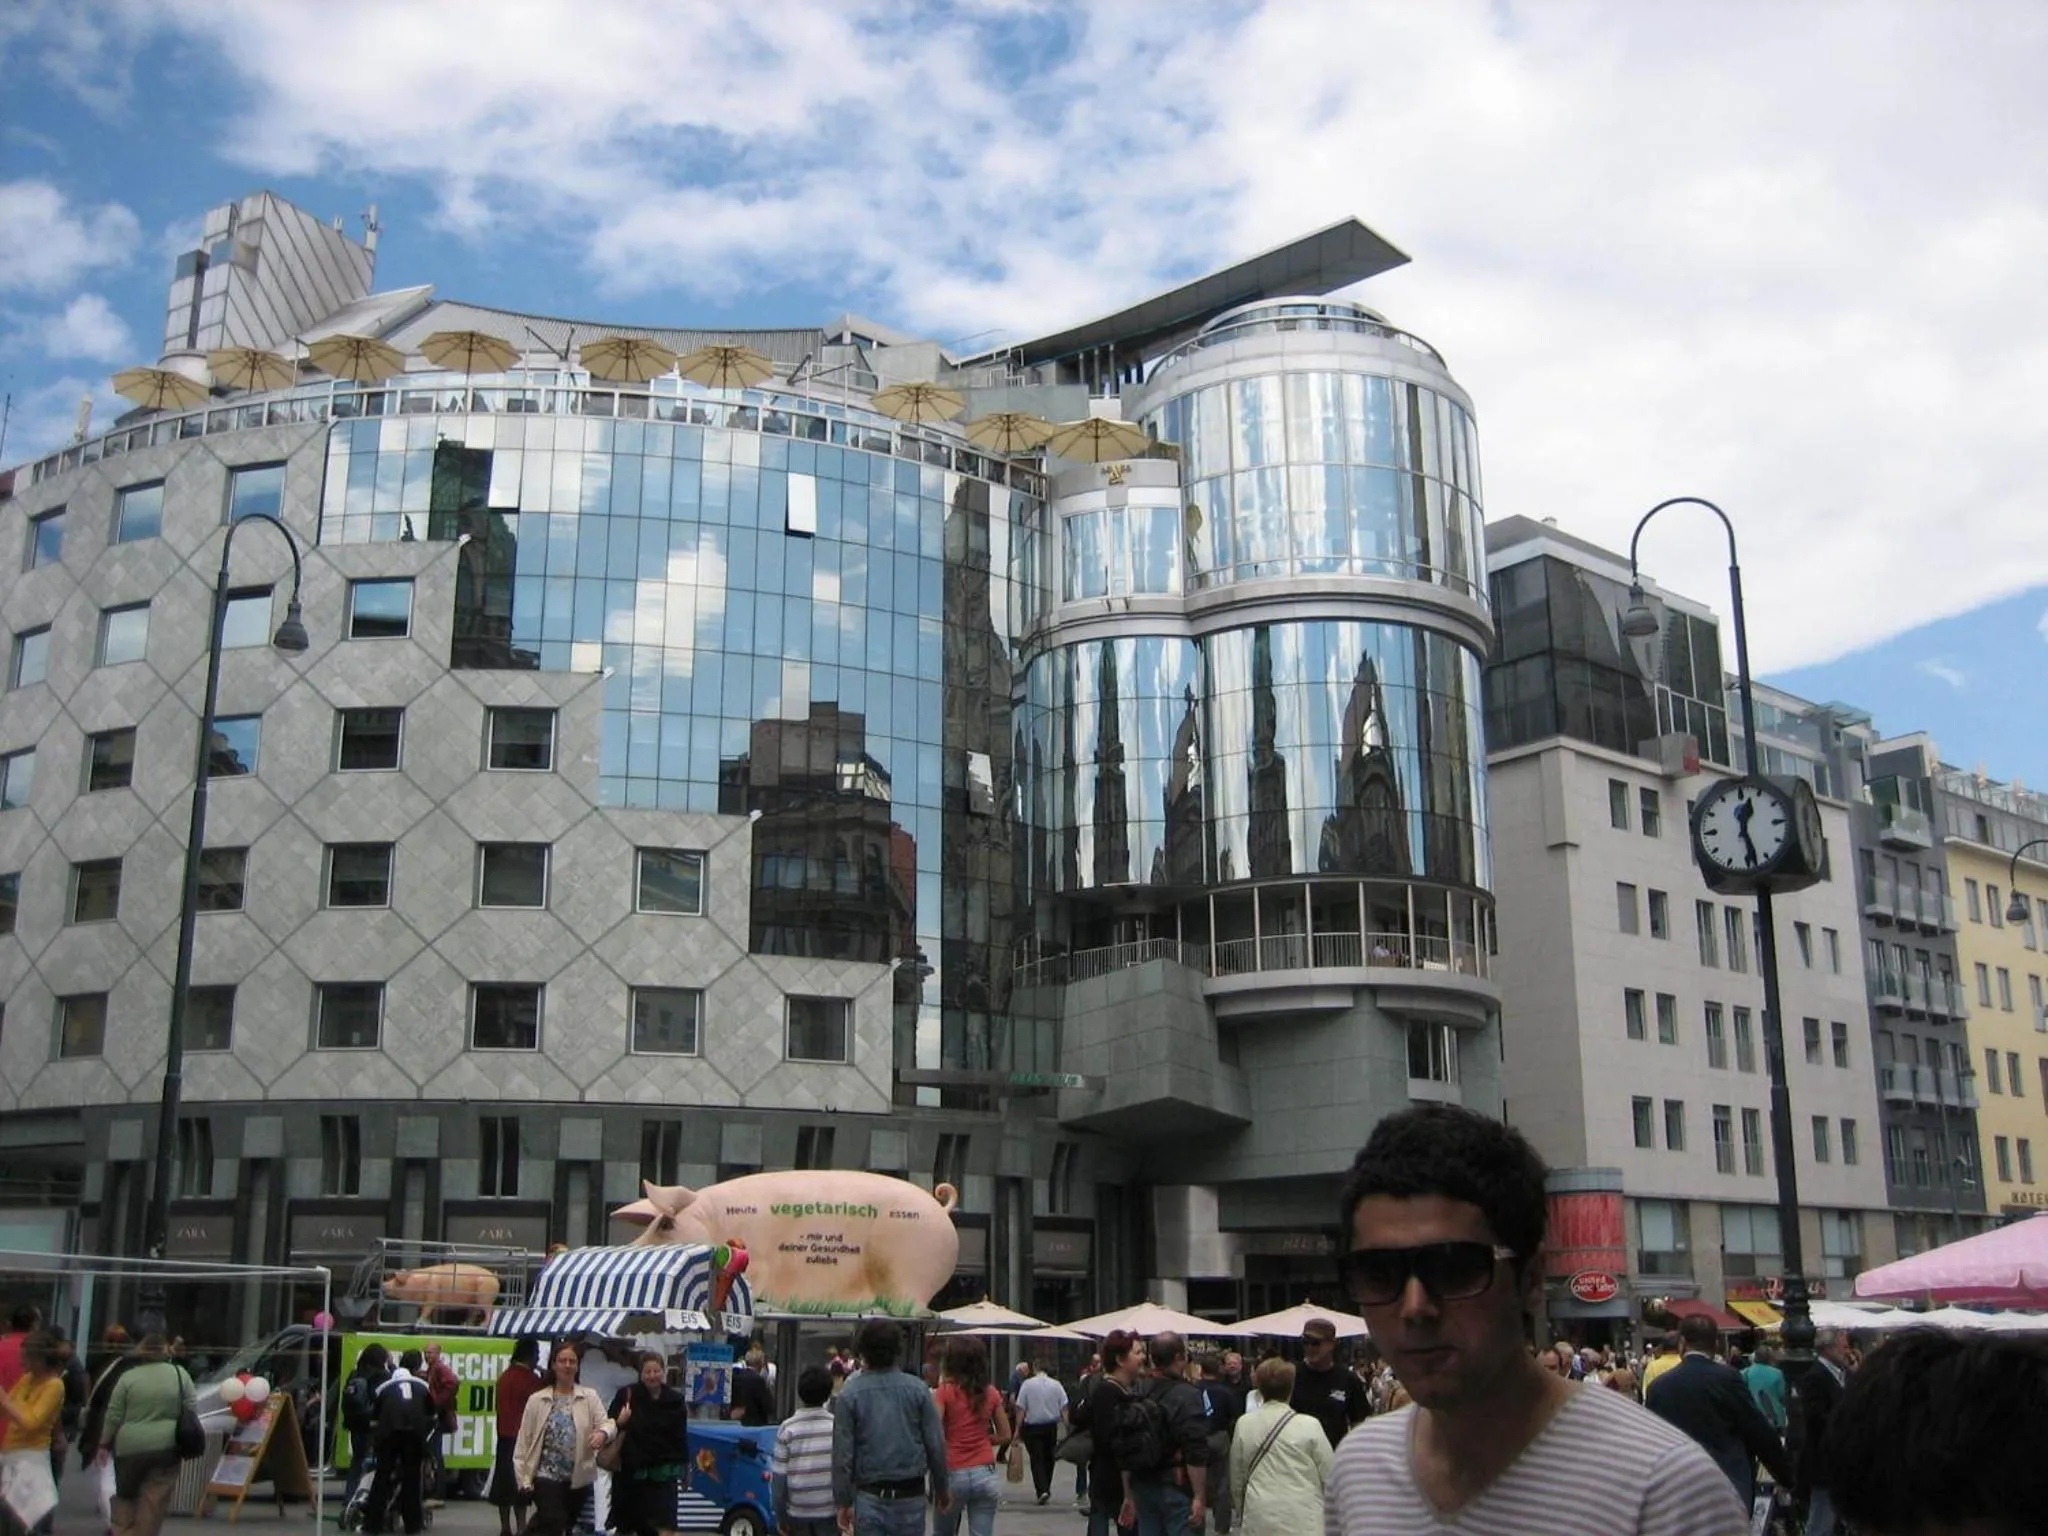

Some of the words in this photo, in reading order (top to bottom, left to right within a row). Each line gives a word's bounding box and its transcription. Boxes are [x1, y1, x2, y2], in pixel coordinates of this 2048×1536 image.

[726, 1205, 758, 1216] Heute
[770, 1201, 878, 1219] vegetarisch
[889, 1210, 919, 1220] essen
[806, 1233, 822, 1242] mir
[825, 1233, 843, 1243] und
[778, 1243, 808, 1253] deiner
[810, 1243, 860, 1255] Gesundheit
[806, 1255, 838, 1265] zuliebe
[681, 1312, 698, 1326] EIS
[726, 1315, 742, 1329] EIS
[470, 1385, 495, 1412] DI
